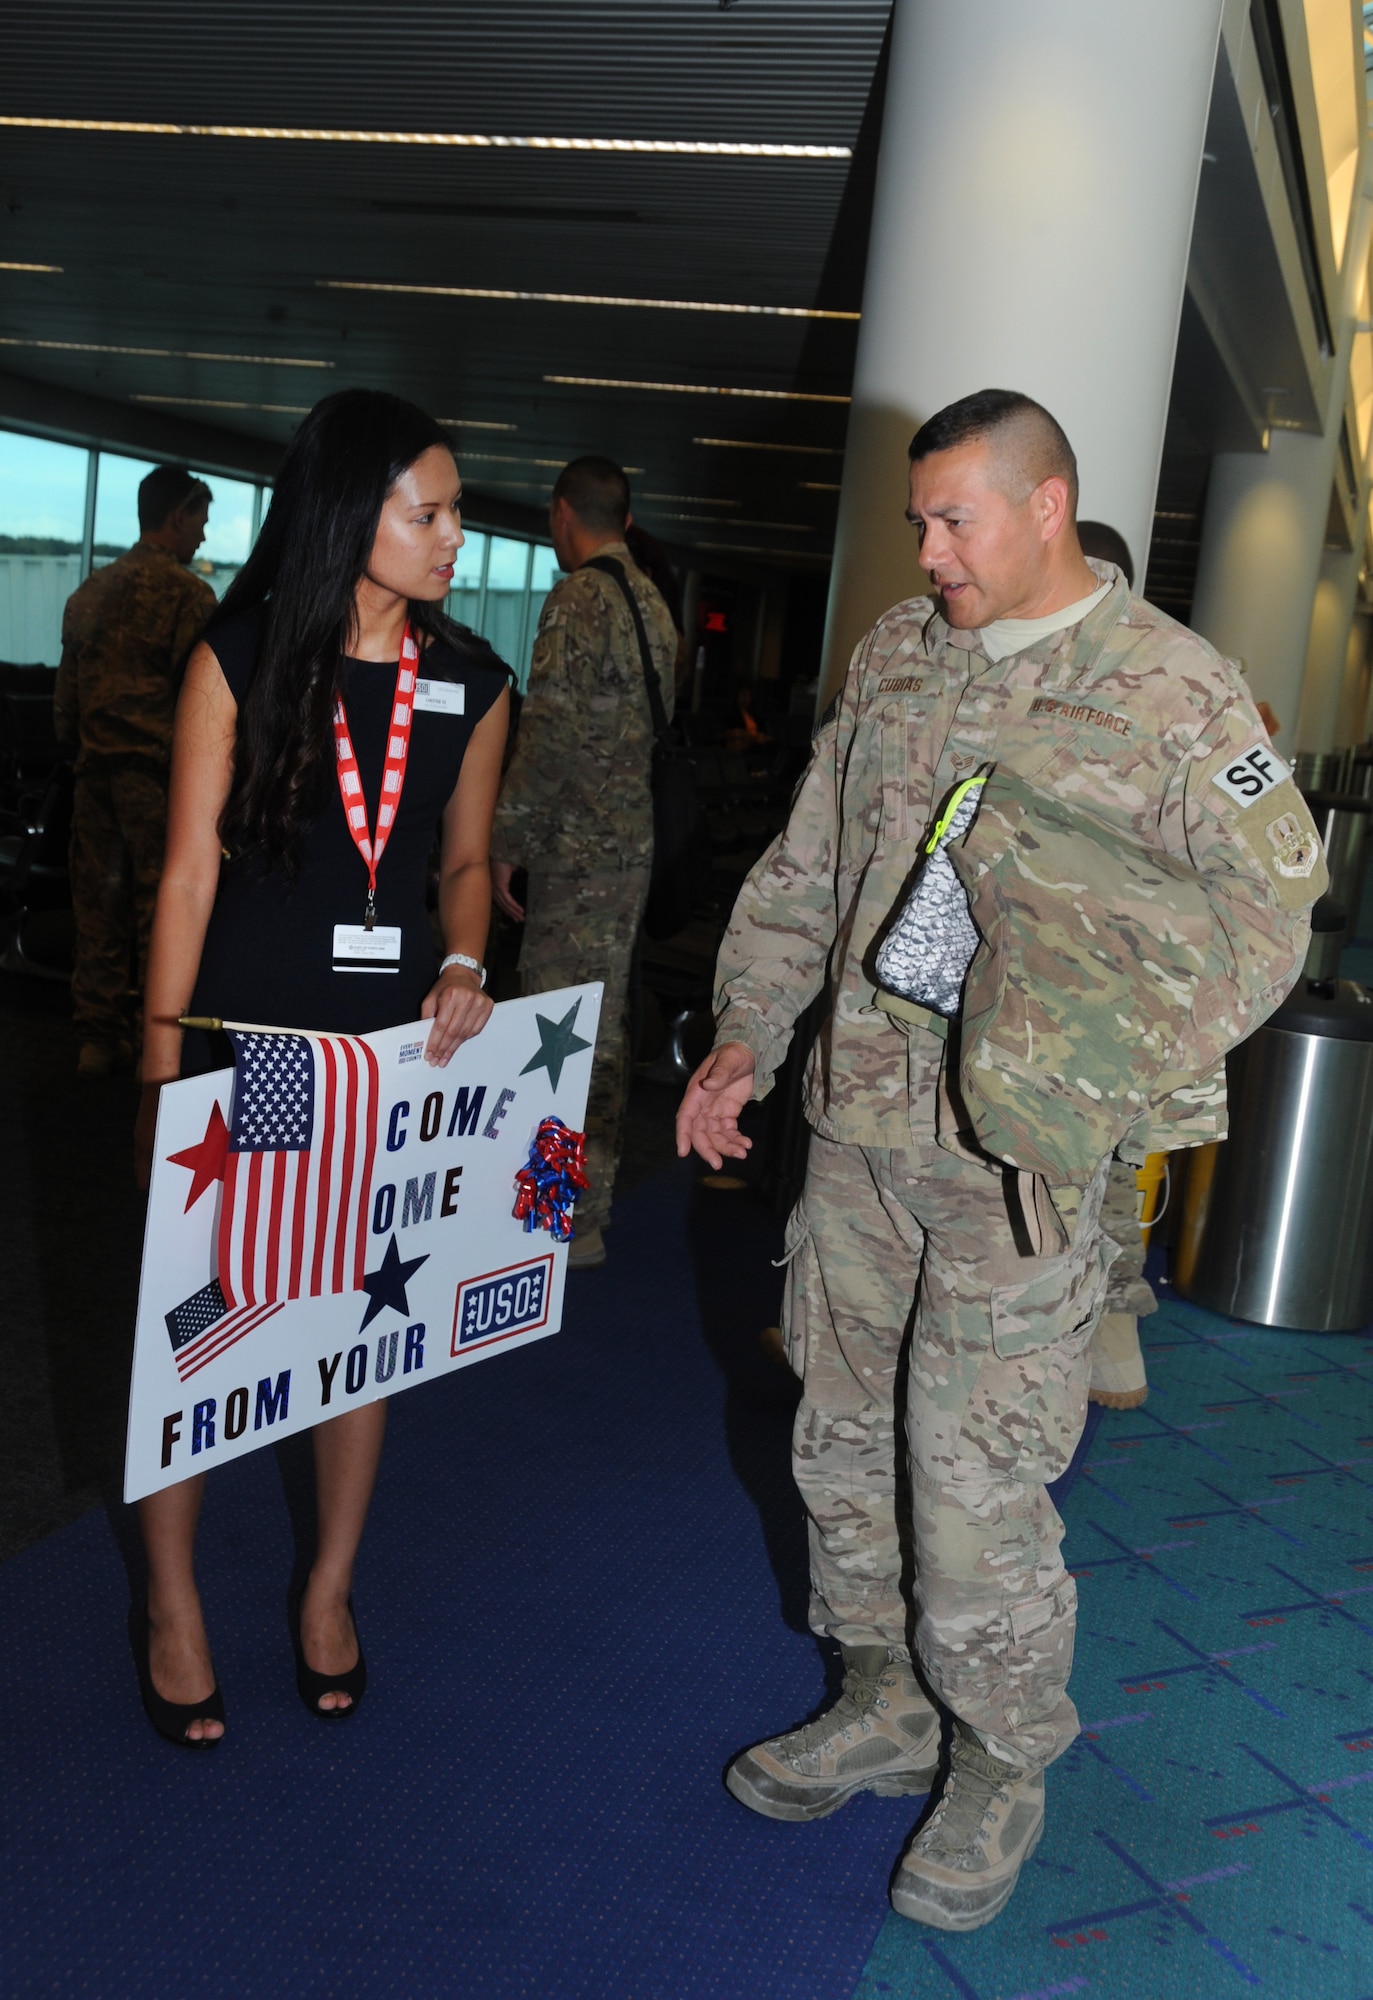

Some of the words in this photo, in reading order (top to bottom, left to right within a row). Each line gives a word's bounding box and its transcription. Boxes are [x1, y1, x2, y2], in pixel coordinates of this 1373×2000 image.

[878, 678, 923, 693] CUBIAS
[1032, 698, 1057, 714] U.S.
[1058, 703, 1085, 721] AIR
[1085, 709, 1133, 737] FORCE
[1226, 749, 1275, 796] SF
[399, 1046, 423, 1057] MOMENT
[372, 1165, 463, 1235] OME
[476, 1276, 531, 1331] USO
[161, 1368, 292, 1469] FROM
[317, 1322, 426, 1407] YOUR
